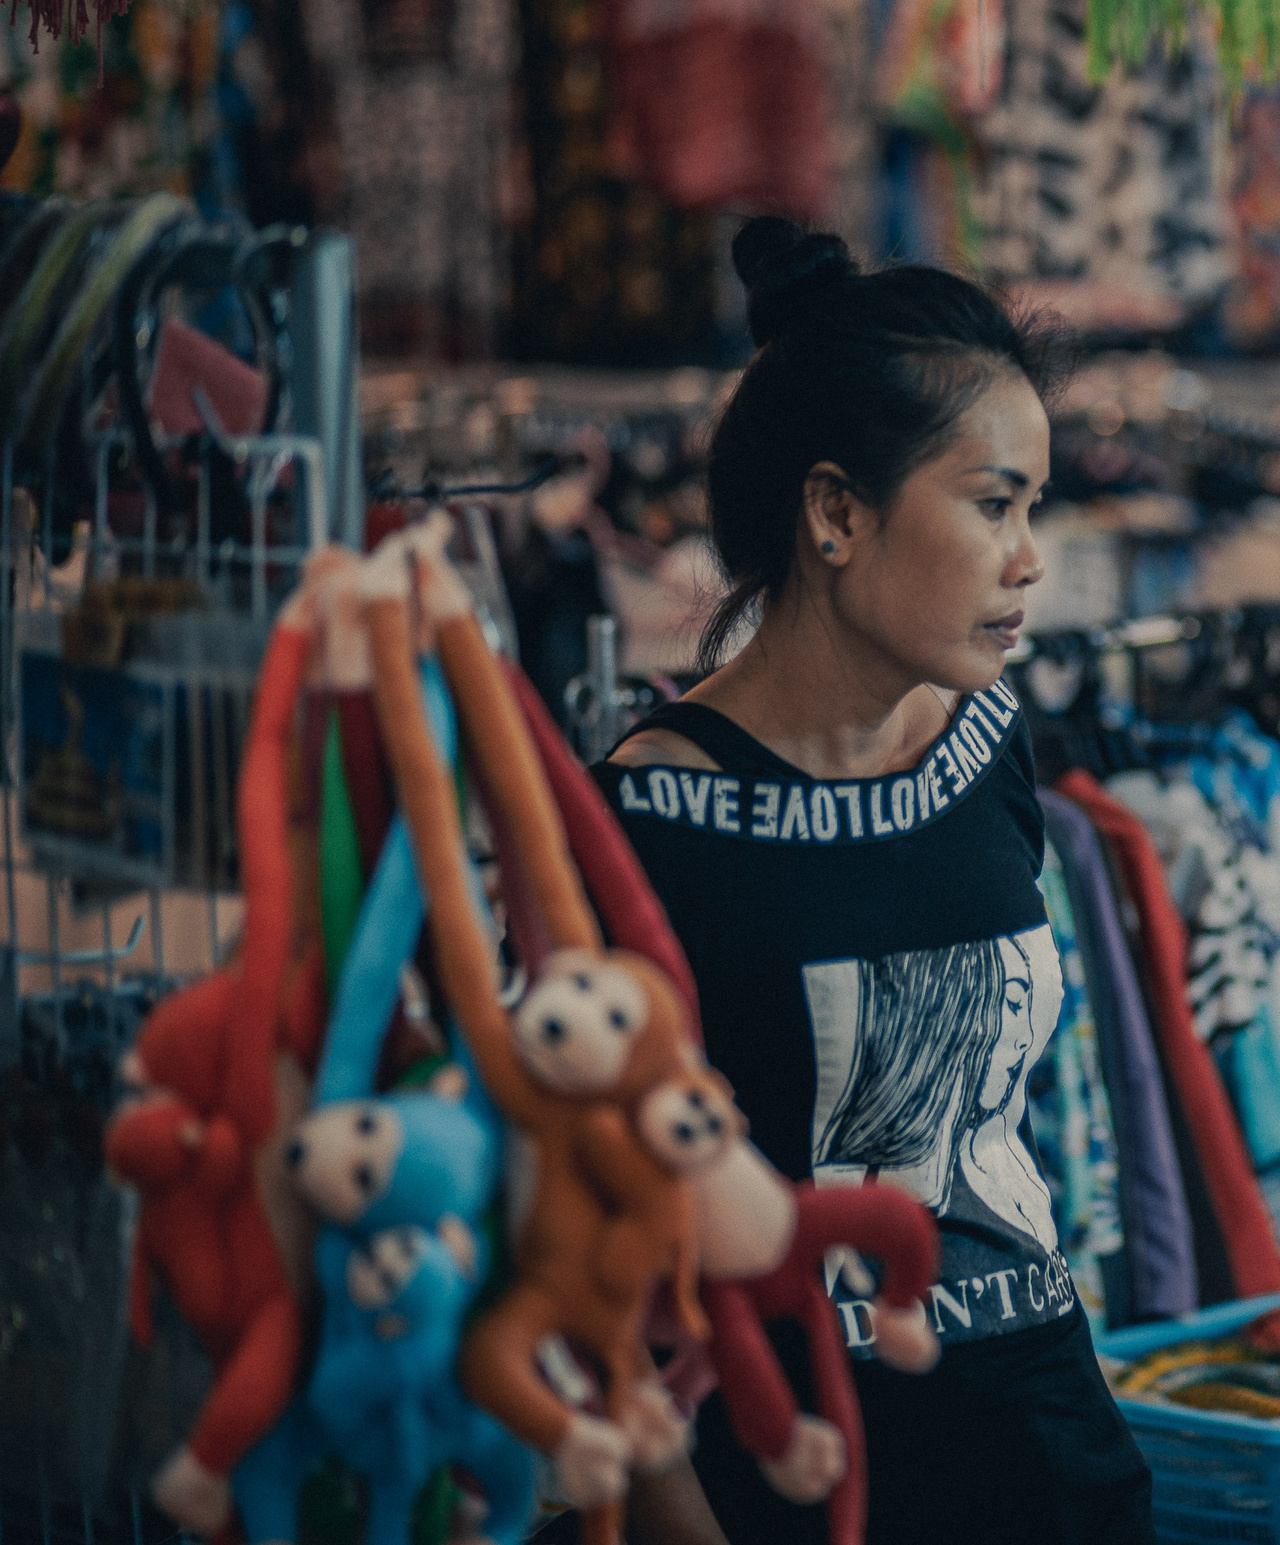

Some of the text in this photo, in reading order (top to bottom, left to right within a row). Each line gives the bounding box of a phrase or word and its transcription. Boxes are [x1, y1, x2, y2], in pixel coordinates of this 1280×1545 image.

[618, 768, 741, 833] LOVE
[870, 757, 950, 836] LOVE
[837, 1268, 1019, 1347] DN'T
